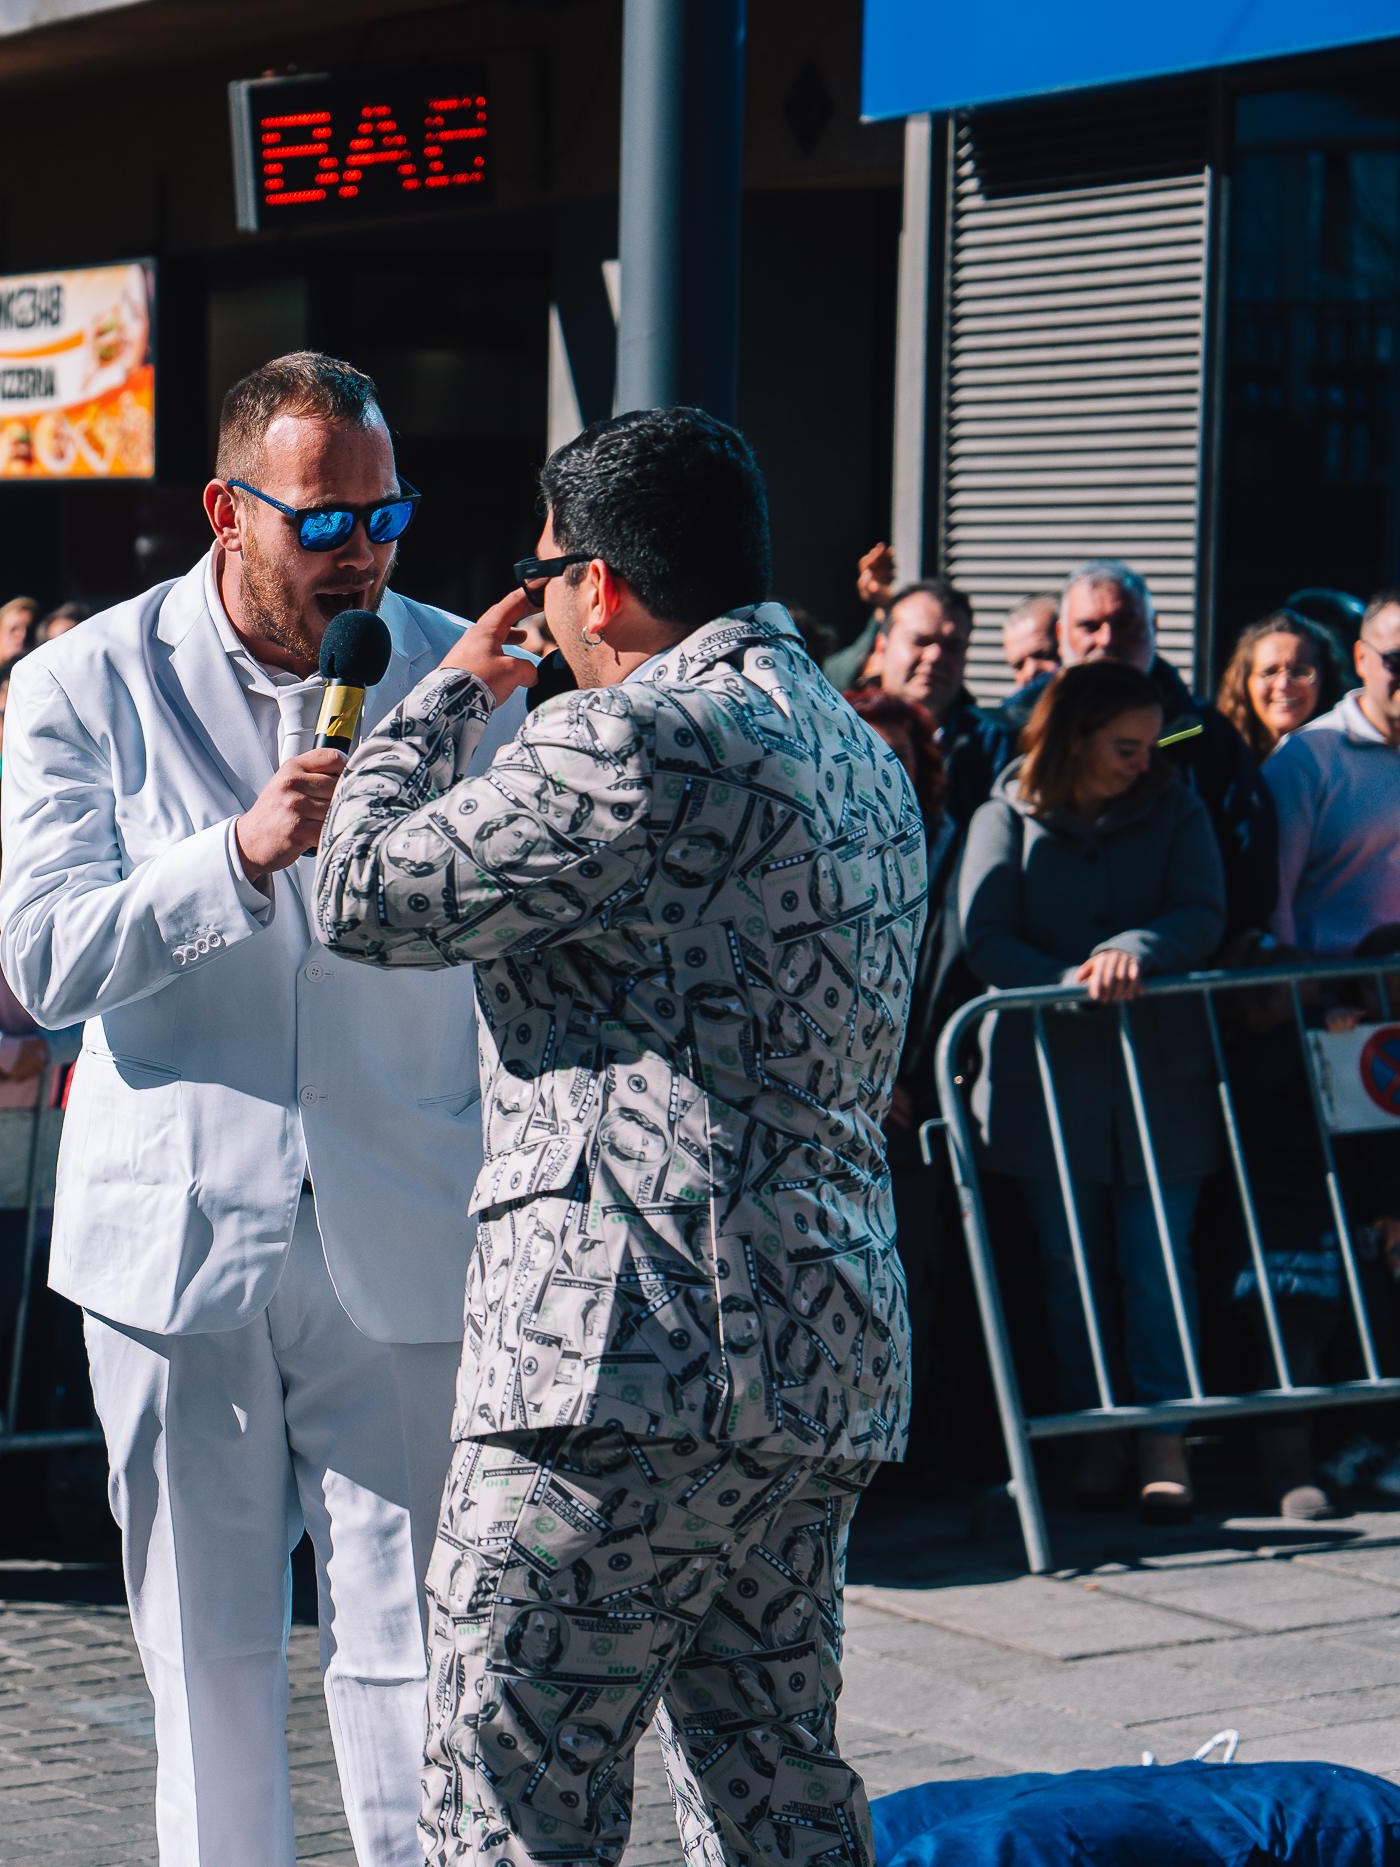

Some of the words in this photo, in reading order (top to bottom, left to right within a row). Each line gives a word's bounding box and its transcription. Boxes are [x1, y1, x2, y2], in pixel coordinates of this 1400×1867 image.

[847, 828, 867, 842] 100
[907, 824, 921, 836] 100
[769, 855, 806, 870] 100
[454, 929, 481, 944] 100
[778, 1181, 809, 1190] 100
[525, 1333, 559, 1347] 100
[486, 1478, 510, 1489] 100
[570, 1497, 607, 1529] 100
[531, 1544, 558, 1567] 100
[757, 1546, 791, 1577] 100
[607, 1666, 637, 1675] 100
[785, 1758, 816, 1772] 100
[772, 1814, 814, 1828] 100
